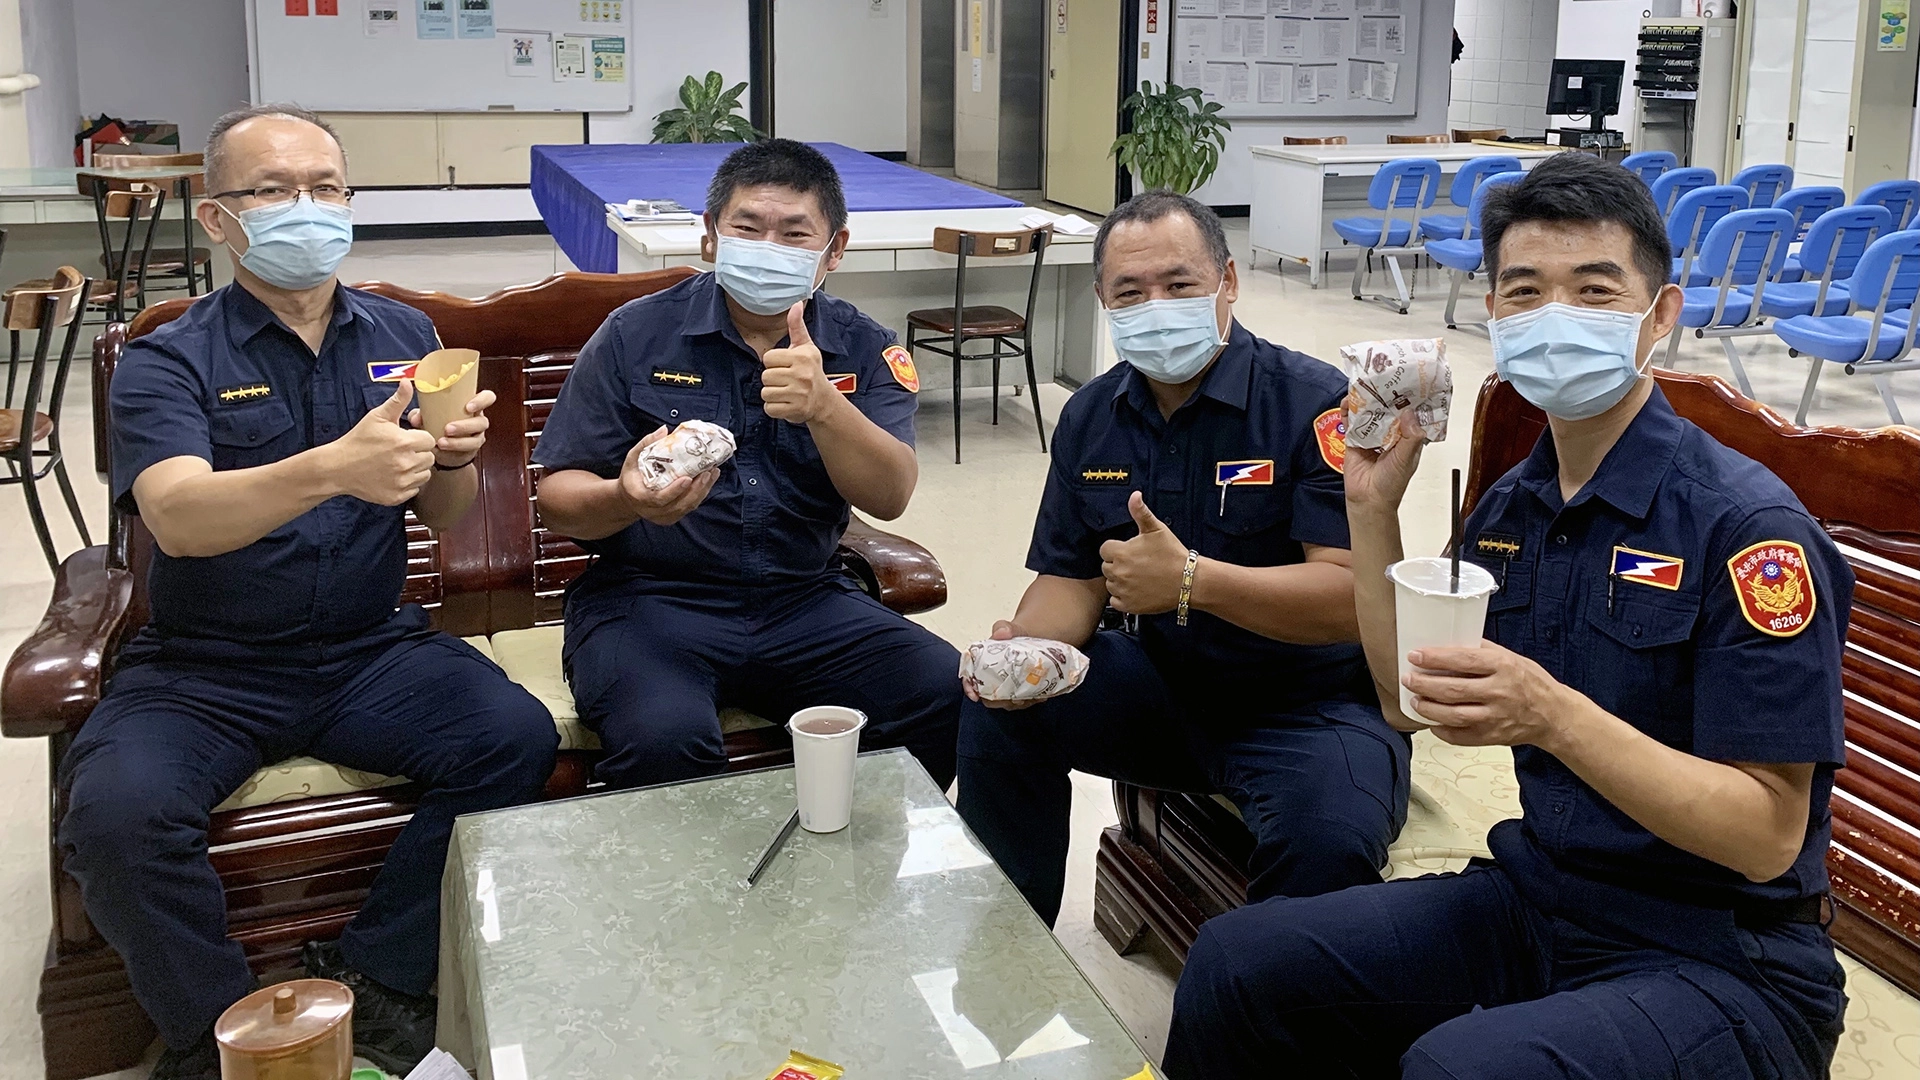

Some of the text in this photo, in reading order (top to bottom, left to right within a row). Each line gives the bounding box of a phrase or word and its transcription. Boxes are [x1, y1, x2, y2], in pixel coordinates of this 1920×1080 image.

[1384, 366, 1405, 389] Coffee
[1735, 547, 1802, 581] 臺北市政府警察局
[1769, 613, 1803, 630] 16206
